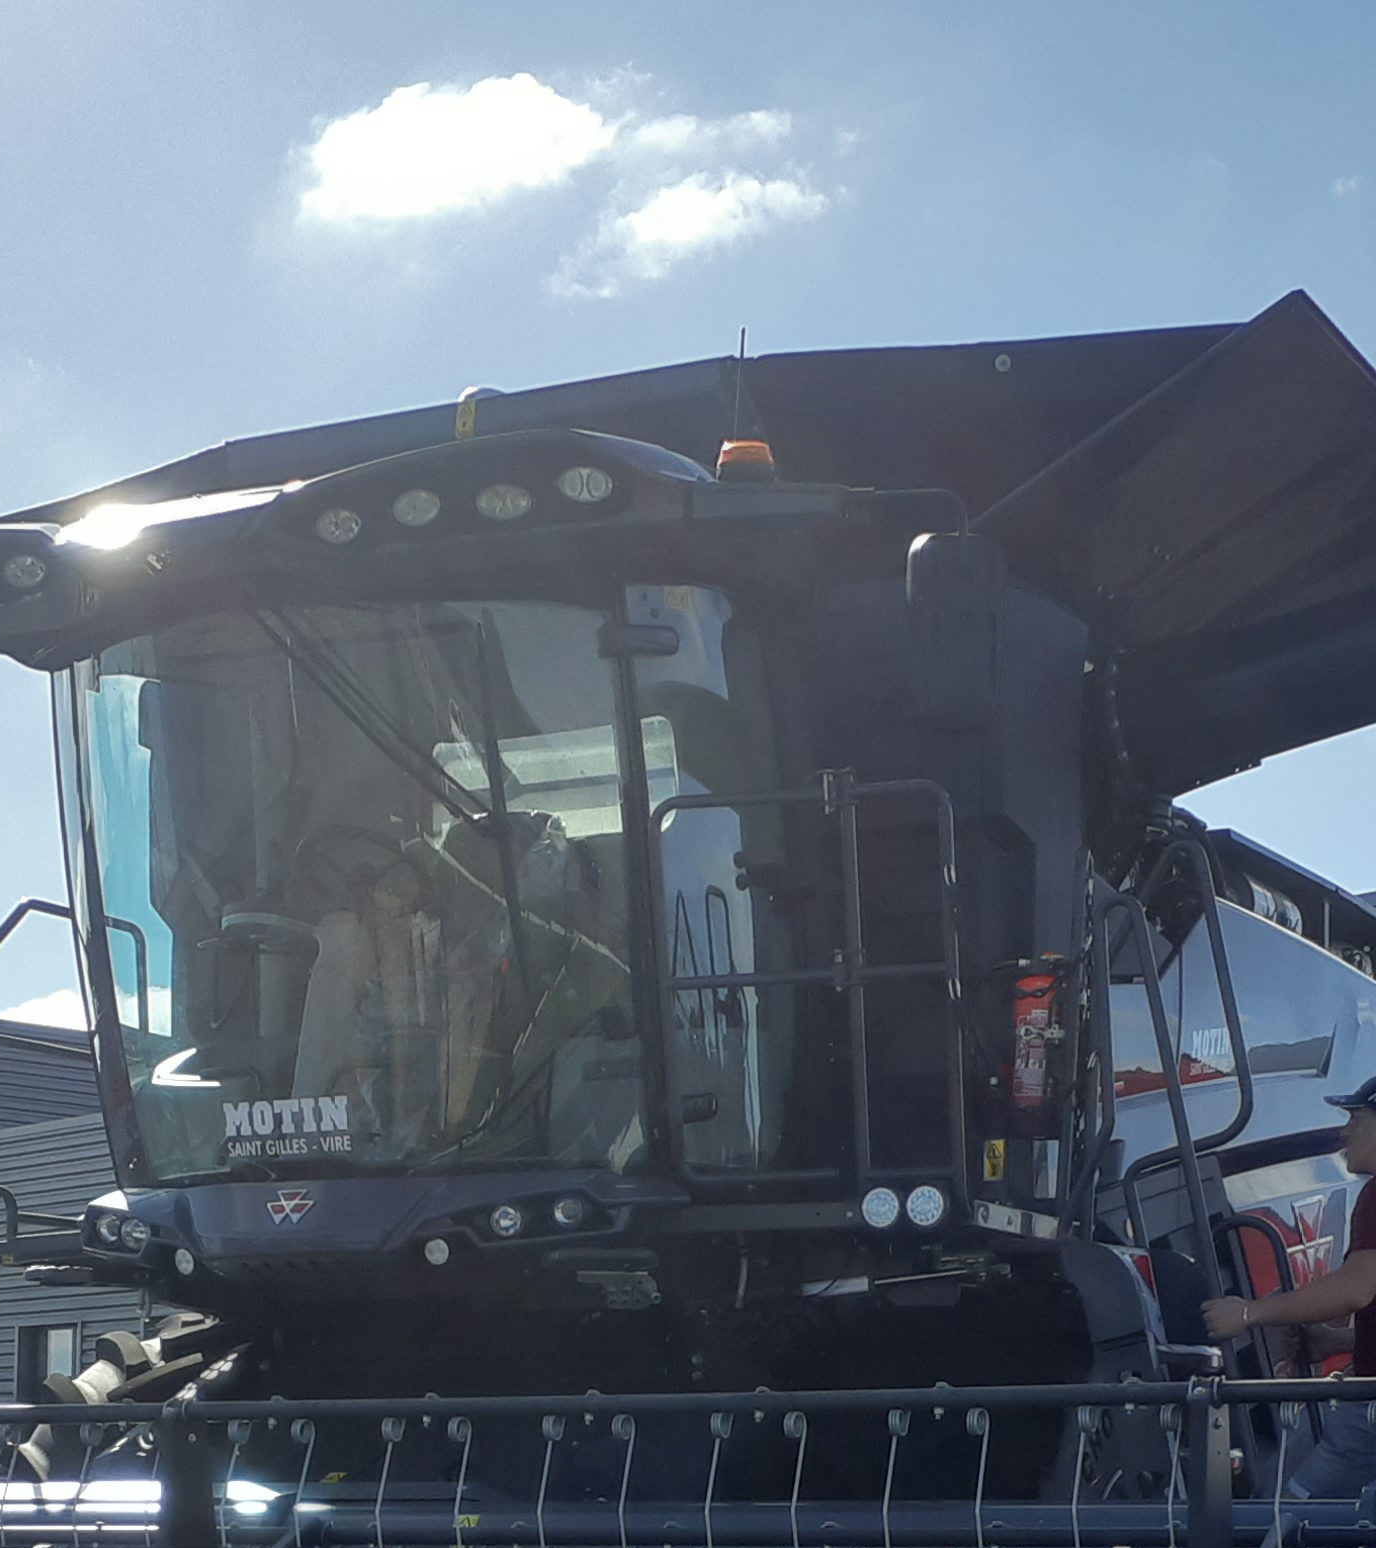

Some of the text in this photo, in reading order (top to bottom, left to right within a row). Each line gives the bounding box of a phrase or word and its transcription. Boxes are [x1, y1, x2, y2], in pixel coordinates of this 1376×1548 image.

[222, 1095, 348, 1137] MOTIN
[227, 1140, 262, 1158] SAINT
[265, 1138, 308, 1156] GILLES
[320, 1135, 352, 1153] VIRE
